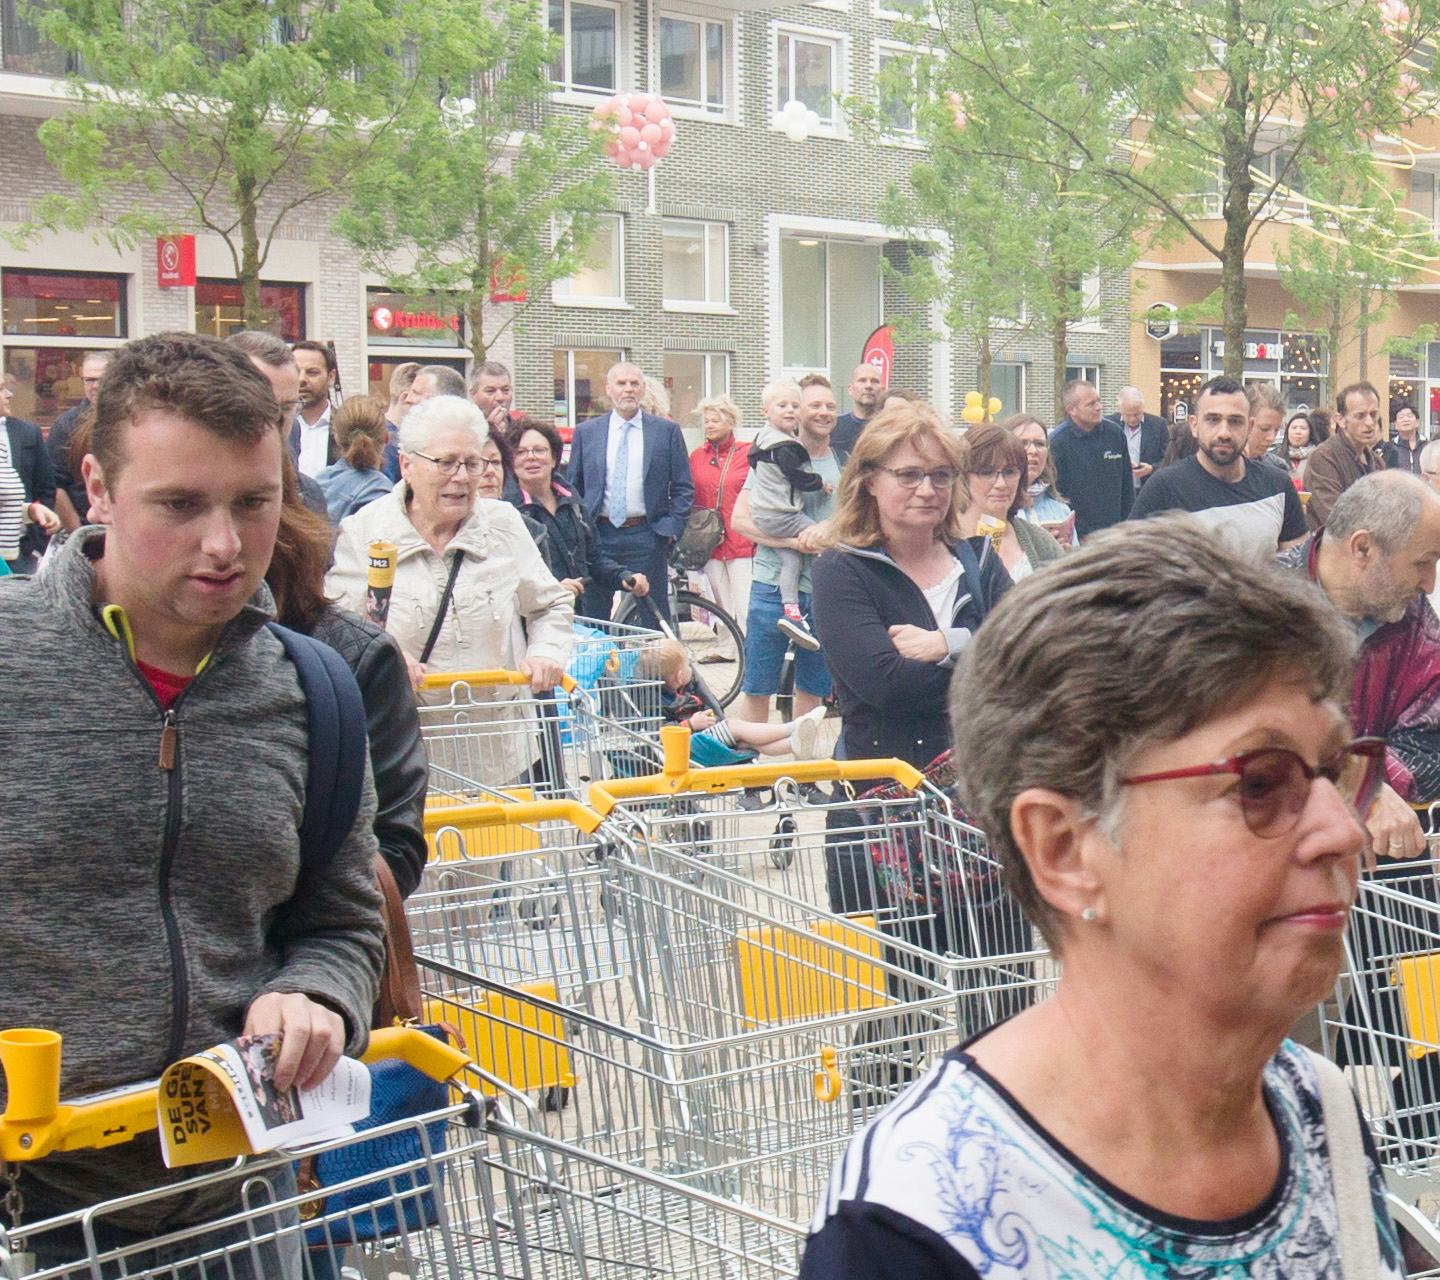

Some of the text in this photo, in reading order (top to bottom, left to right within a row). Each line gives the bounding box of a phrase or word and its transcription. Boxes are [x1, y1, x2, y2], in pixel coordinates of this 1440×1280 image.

[169, 1107, 186, 1145] DE
[180, 1065, 198, 1134] SUPE
[193, 1079, 212, 1135] VAN
